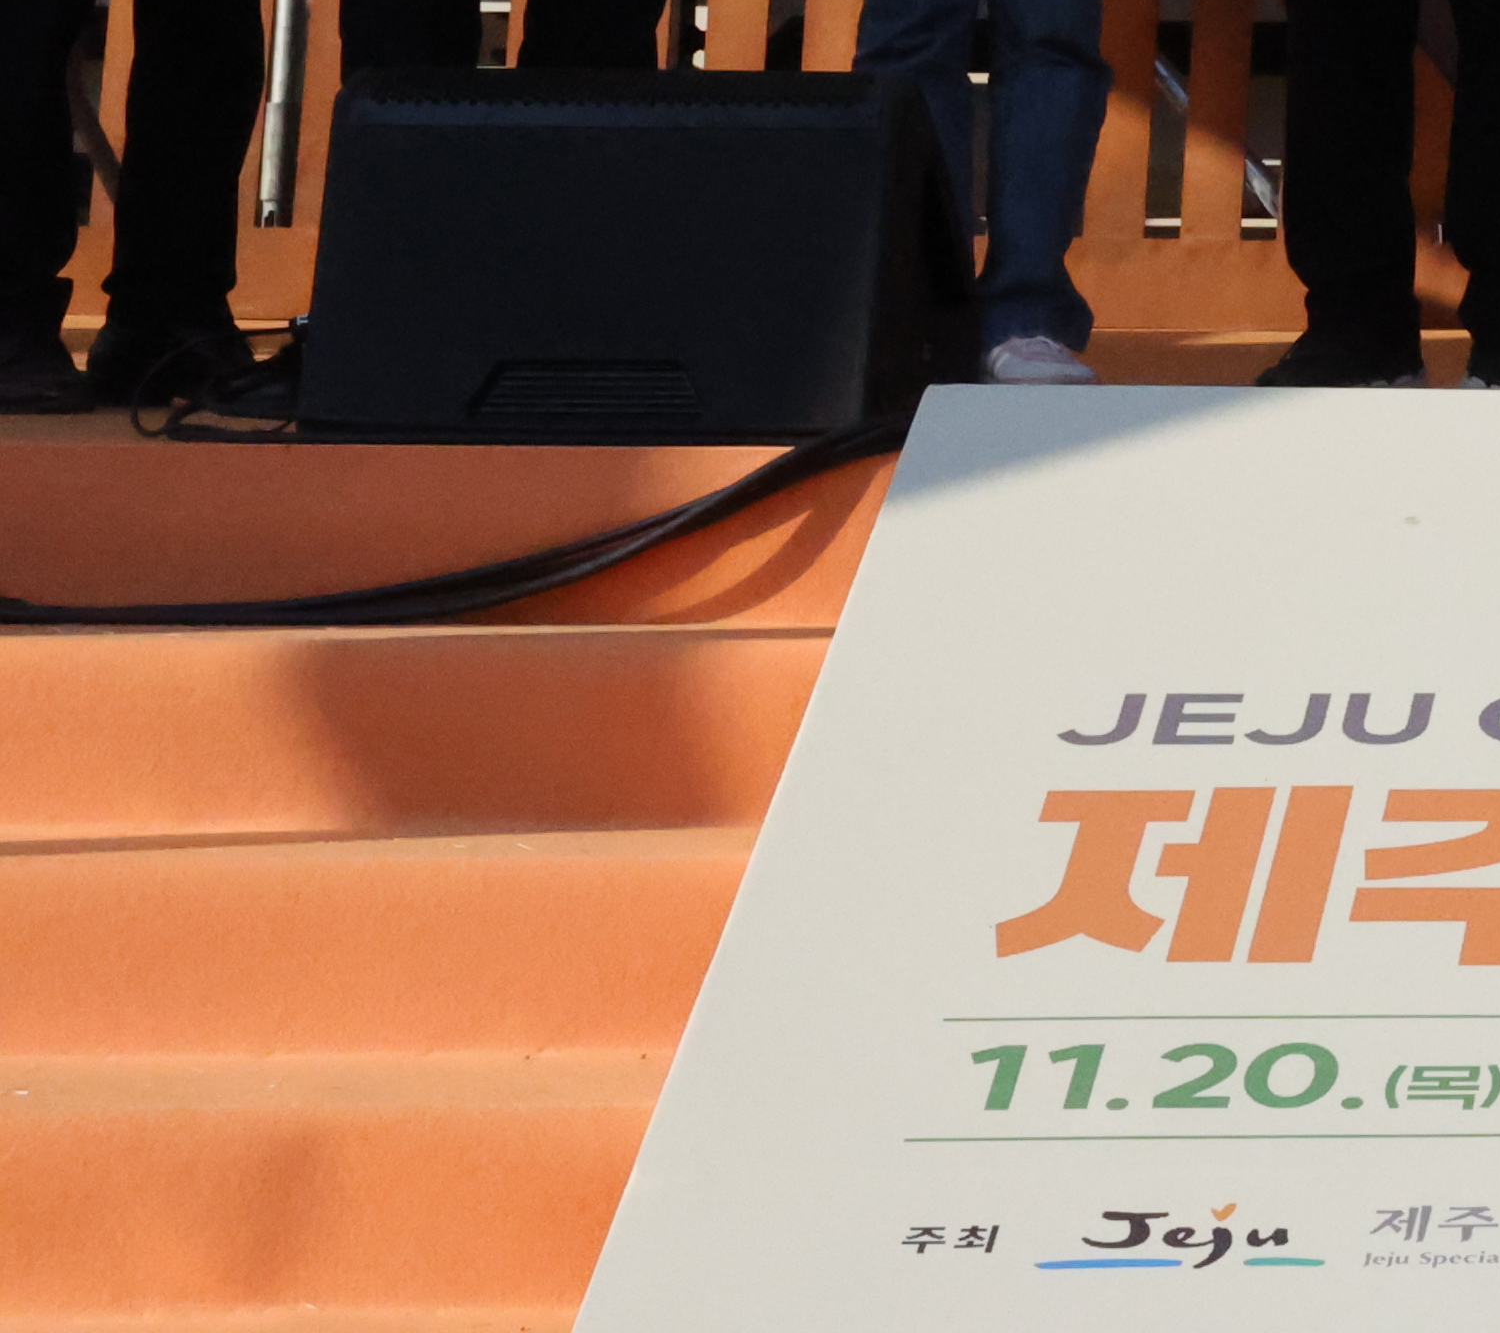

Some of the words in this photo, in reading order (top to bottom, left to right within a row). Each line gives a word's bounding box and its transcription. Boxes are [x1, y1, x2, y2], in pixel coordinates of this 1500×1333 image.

[1057, 691, 1436, 747] JEJU
[1081, 1202, 1290, 1269] Jeju
[1363, 1251, 1409, 1268] Jeju
